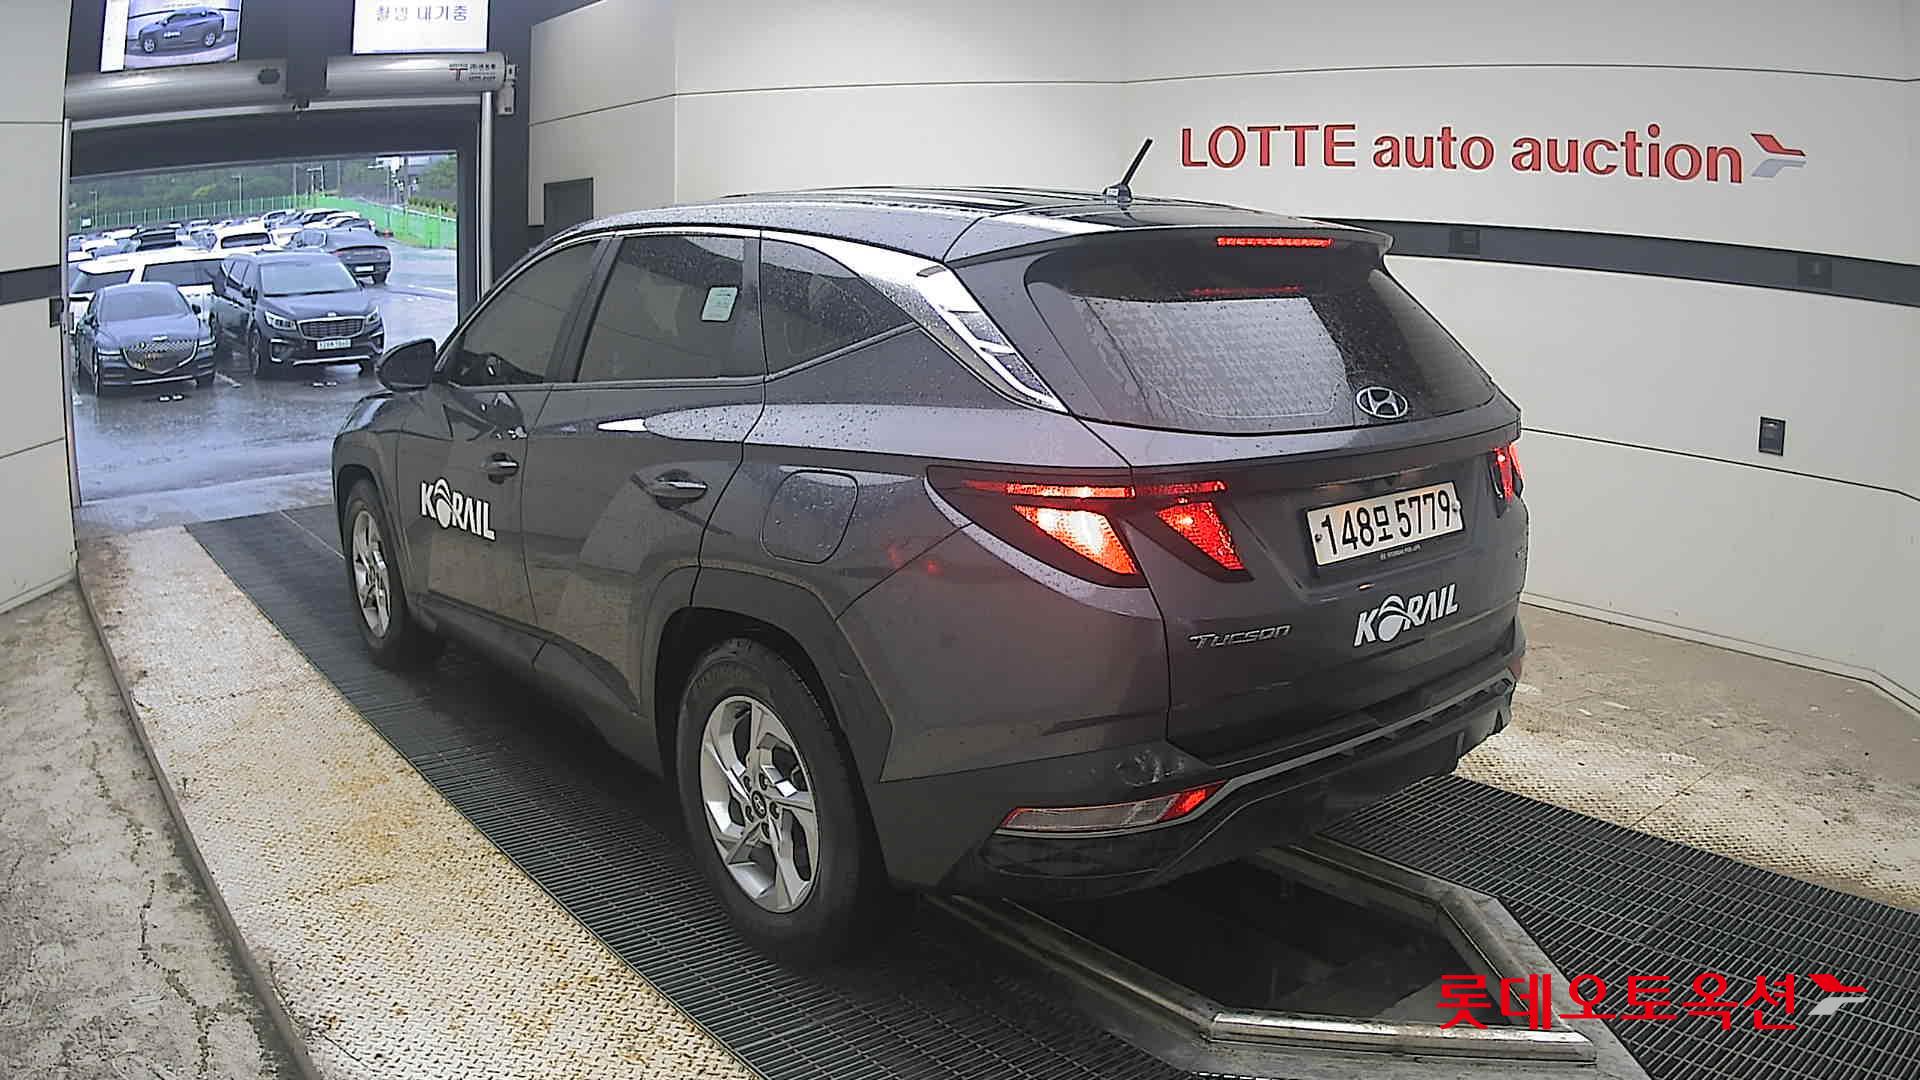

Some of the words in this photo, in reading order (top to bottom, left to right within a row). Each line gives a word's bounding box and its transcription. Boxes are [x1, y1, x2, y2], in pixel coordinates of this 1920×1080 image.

[1181, 125, 1355, 167] LOTTE
[1373, 127, 1495, 170] auto
[1512, 124, 1743, 184] auction
[420, 478, 496, 541] KORAIL
[1354, 583, 1459, 647] KORAIL
